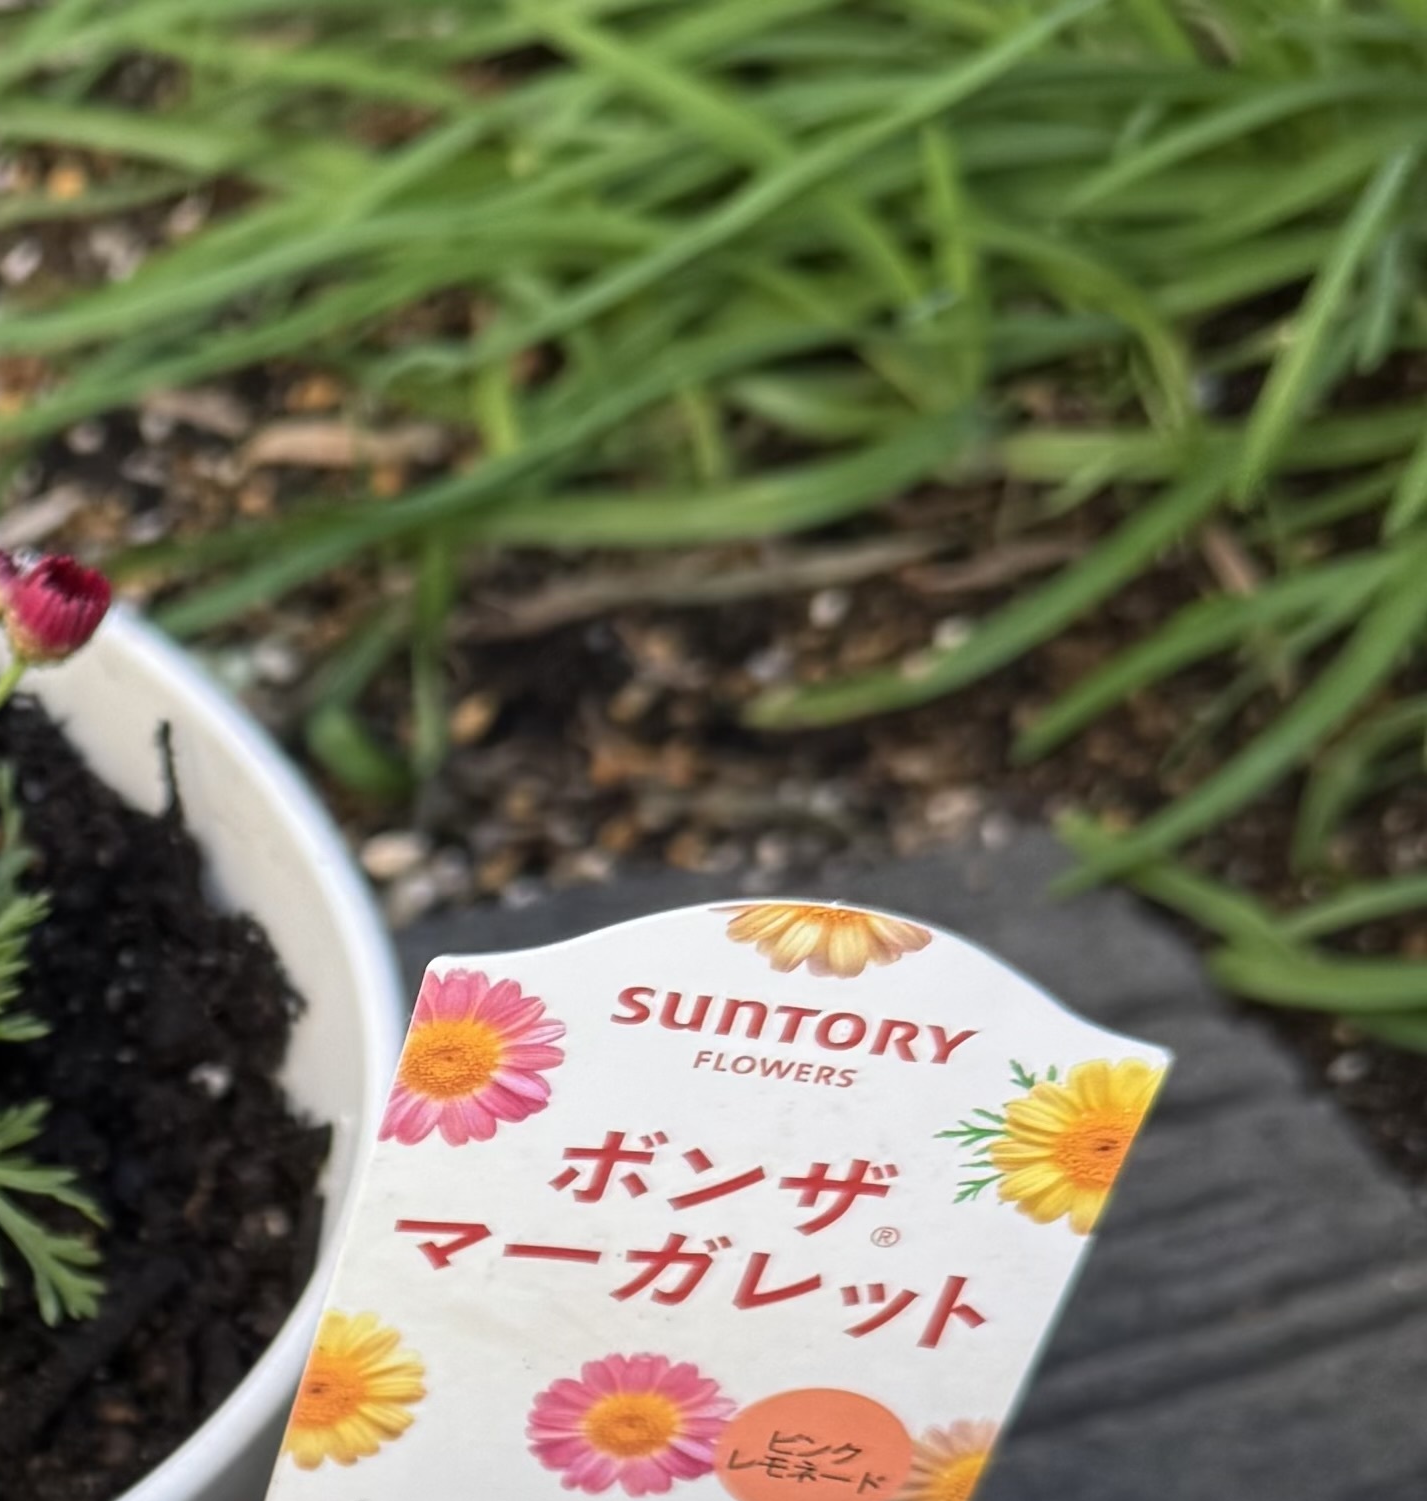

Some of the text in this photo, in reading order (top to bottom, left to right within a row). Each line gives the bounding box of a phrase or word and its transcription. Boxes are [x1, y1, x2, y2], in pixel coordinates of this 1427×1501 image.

[610, 986, 979, 1064] SUNTORY
[693, 1050, 859, 1089] FLOWERS
[394, 1217, 986, 1349] マーガレット
[768, 1430, 863, 1464] ピンク
[727, 1449, 886, 1494] レモネード
